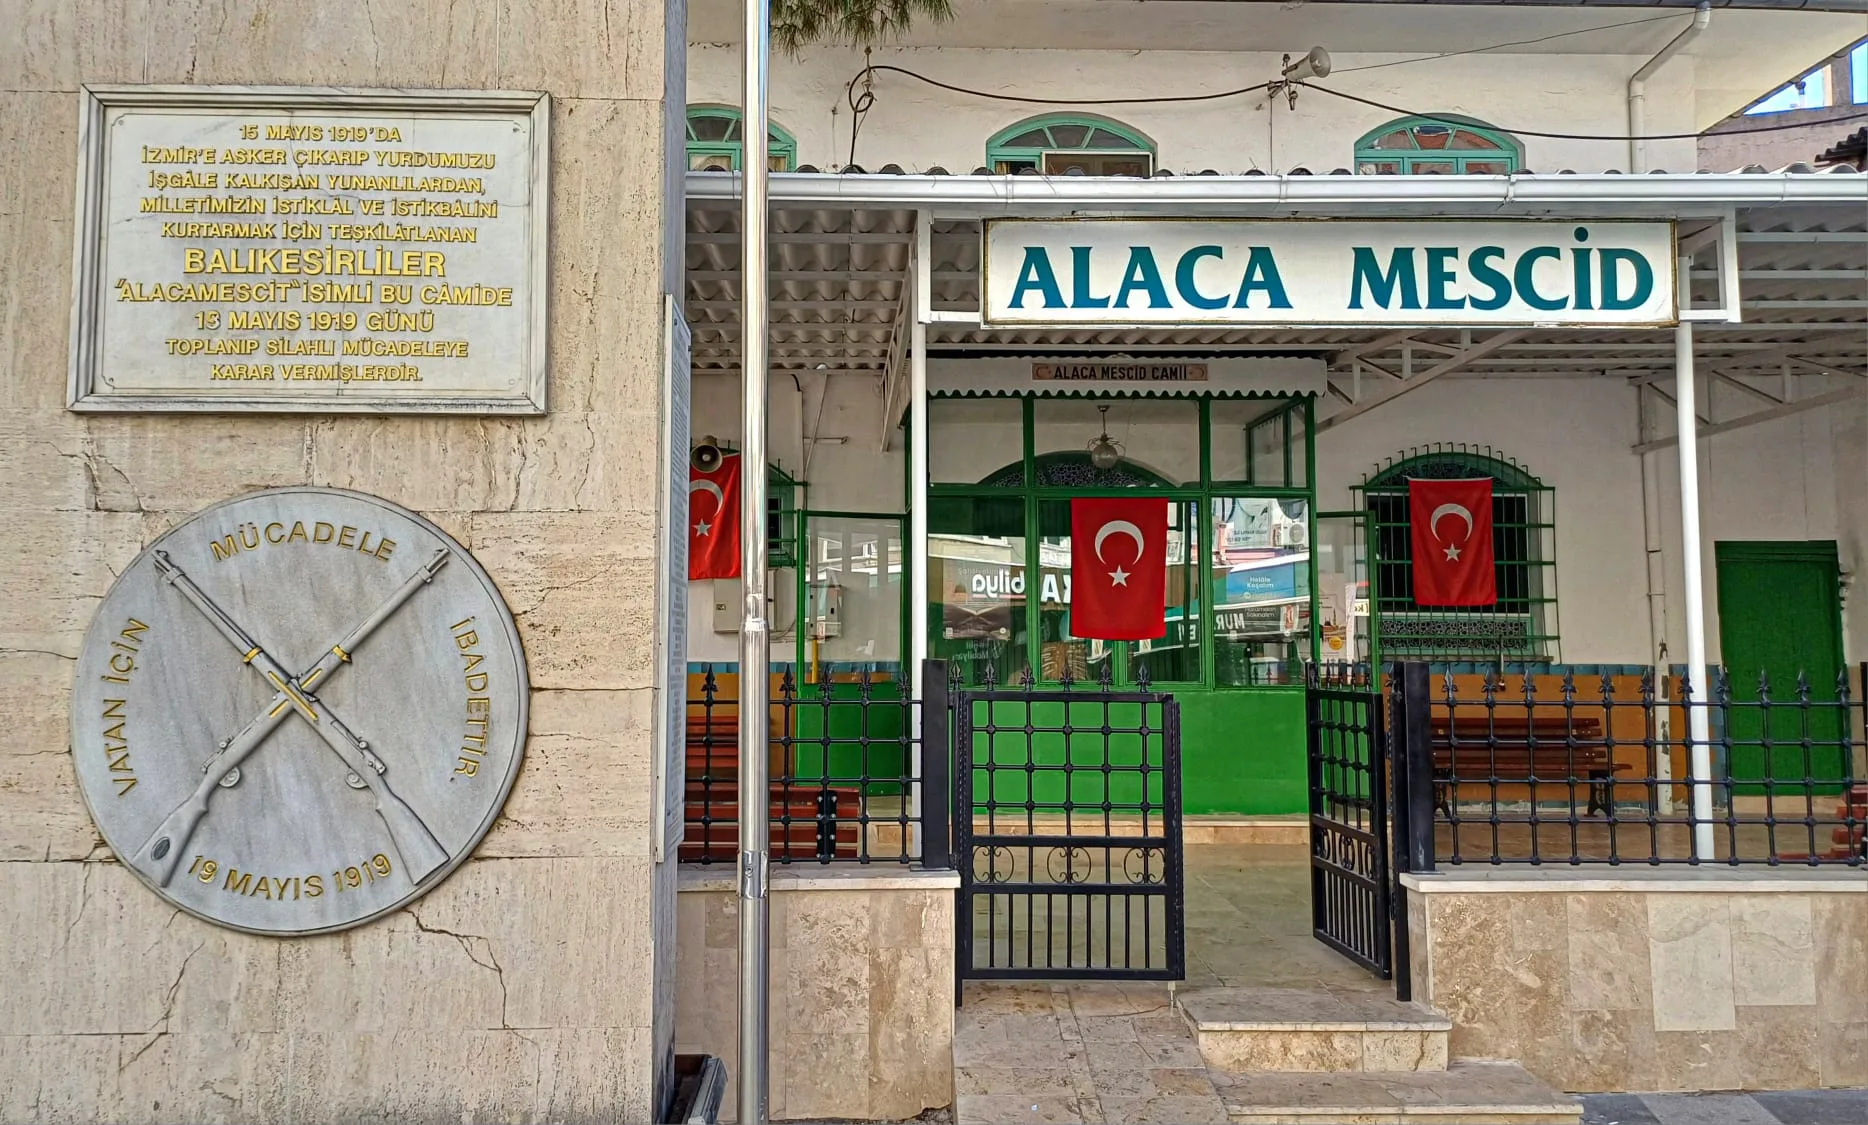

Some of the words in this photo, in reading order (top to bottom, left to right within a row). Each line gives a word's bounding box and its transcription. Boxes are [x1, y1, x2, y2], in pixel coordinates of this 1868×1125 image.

[239, 124, 259, 140] 15
[265, 125, 323, 141] MAYIS
[328, 126, 401, 142] 1919'DA
[141, 145, 216, 164] İZMİR'E
[219, 149, 287, 165] ASKER
[293, 149, 370, 168] ÇIKARIP
[375, 151, 496, 169] YURDUMUZU
[148, 169, 218, 190] İŞGÂLE
[224, 173, 319, 192] KALKIŞAN
[327, 174, 486, 196] YUNANLILARDAN,
[140, 194, 265, 215] MİLLETİMİZİN
[272, 196, 353, 215] İSTİKLÂL
[360, 200, 385, 215] VE
[161, 221, 276, 239] KURTARMAK
[282, 220, 322, 243] İÇİN
[184, 244, 446, 277] BALIKESİRLİLER
[1006, 244, 1294, 310] ALACA
[1347, 226, 1654, 311] MESCİD
[301, 279, 372, 304] İSİMLİ
[380, 284, 412, 304] BU
[420, 282, 513, 306] CÂMİDE
[227, 310, 301, 331] MAYIS
[307, 311, 358, 331] 1919
[366, 308, 434, 332] GÜNÜ
[165, 338, 259, 355] TOPLANIP
[266, 336, 335, 356] SİLAHLI
[342, 337, 469, 358] MÜCADELEYE
[210, 363, 274, 380] KARAR
[279, 362, 424, 384] VERMİŞLERDİR.
[1054, 366, 1097, 380] ALACA
[1101, 365, 1147, 380] MESCİD
[209, 520, 397, 564] MÜCADELE
[100, 617, 151, 688] İÇİN
[102, 696, 138, 796] VATAN
[187, 855, 217, 884] 19
[221, 868, 324, 901] MAYIS
[333, 853, 394, 893] 1919
